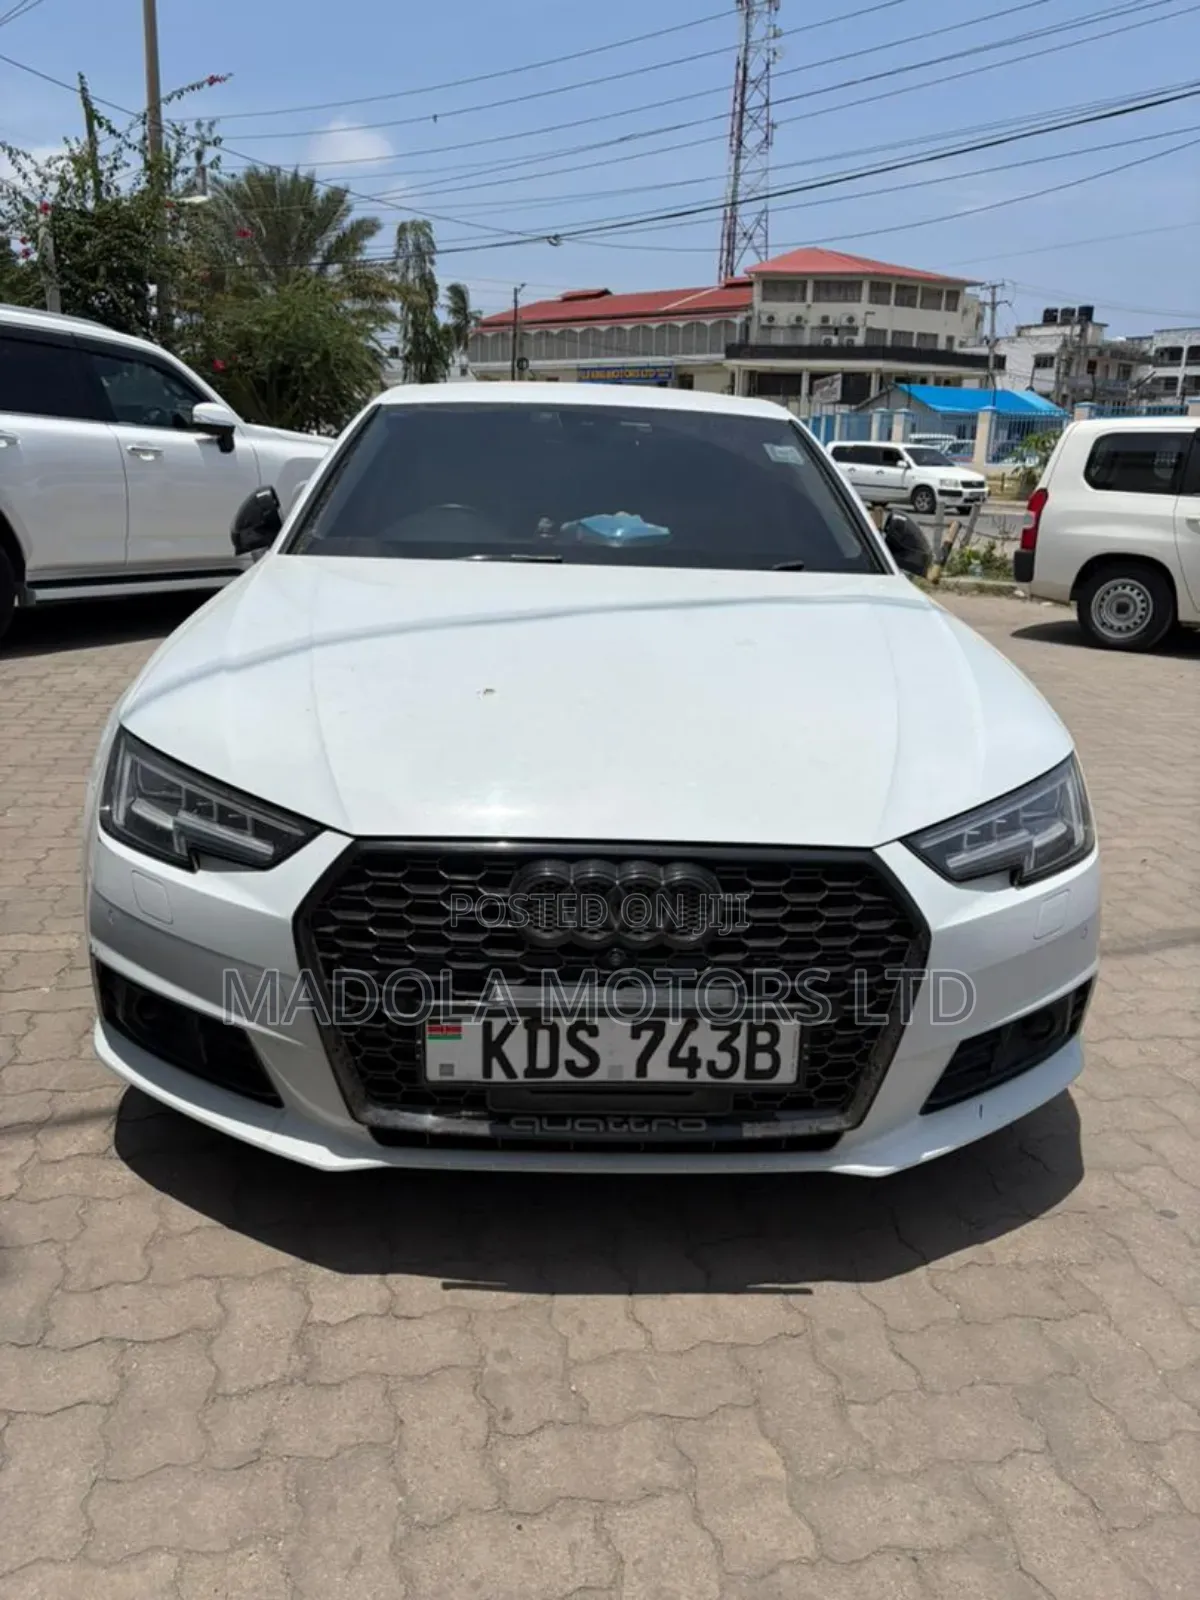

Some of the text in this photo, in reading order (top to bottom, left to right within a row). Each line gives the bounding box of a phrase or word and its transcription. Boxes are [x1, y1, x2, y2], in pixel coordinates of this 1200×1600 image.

[482, 1020, 600, 1080] KDS
[630, 1019, 781, 1081] 743B
[510, 1116, 707, 1135] quattro
